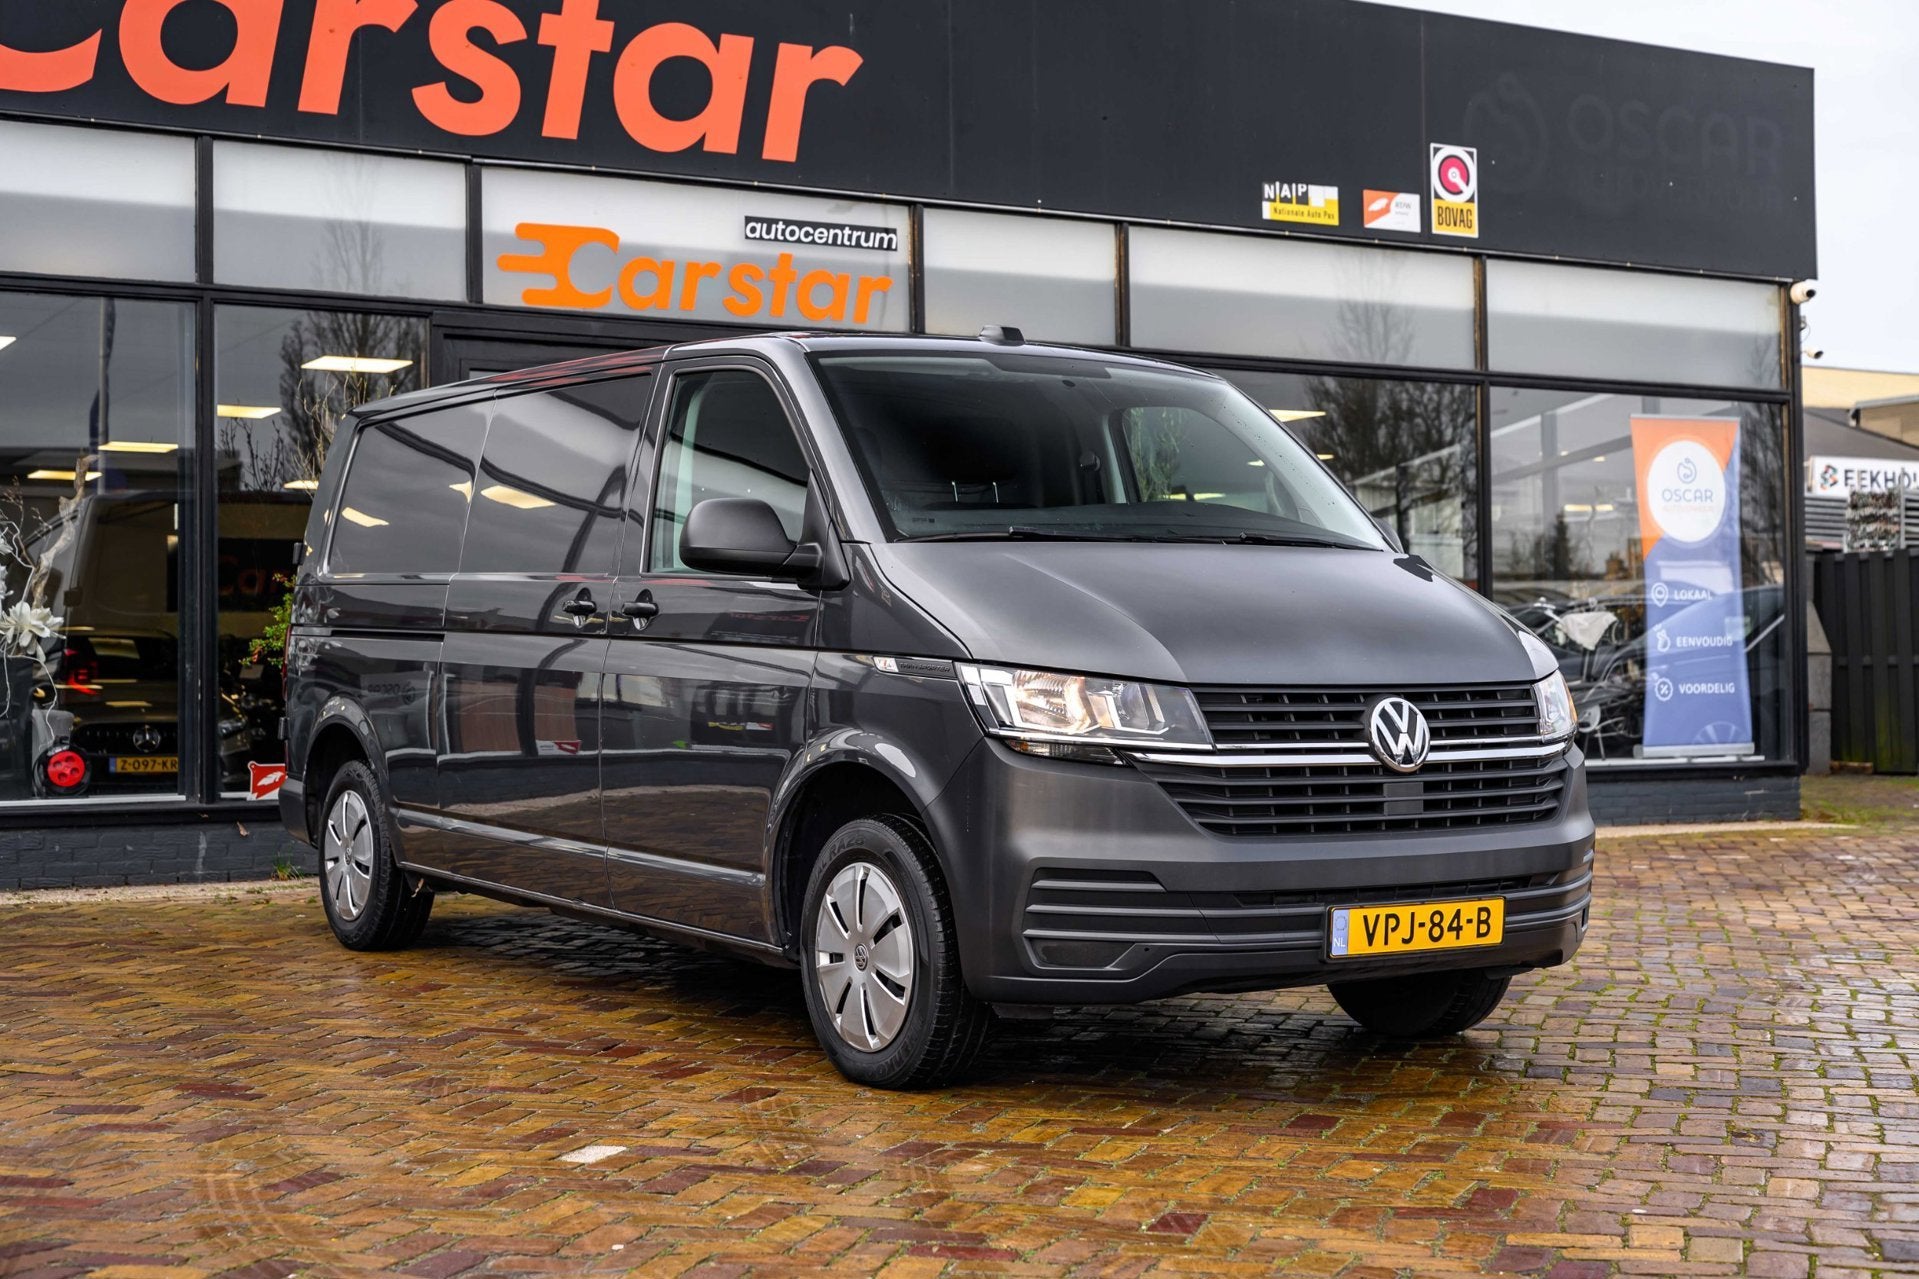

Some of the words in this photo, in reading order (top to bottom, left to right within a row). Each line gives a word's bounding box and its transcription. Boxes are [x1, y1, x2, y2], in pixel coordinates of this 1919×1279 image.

[0, 0, 864, 163] arstar
[1437, 205, 1472, 229] BOVAG
[745, 221, 897, 249] autocentrum
[496, 222, 892, 324] Carstar
[1662, 488, 1713, 503] OSCAR
[1674, 589, 1713, 600] LOKAAL
[1676, 636, 1733, 647] EENVOUDIG
[1678, 683, 1735, 694] VOORDELIG
[120, 757, 178, 771] Z-097-KR
[1363, 906, 1491, 947] VPJ-84-B
[1333, 937, 1346, 948] NL
